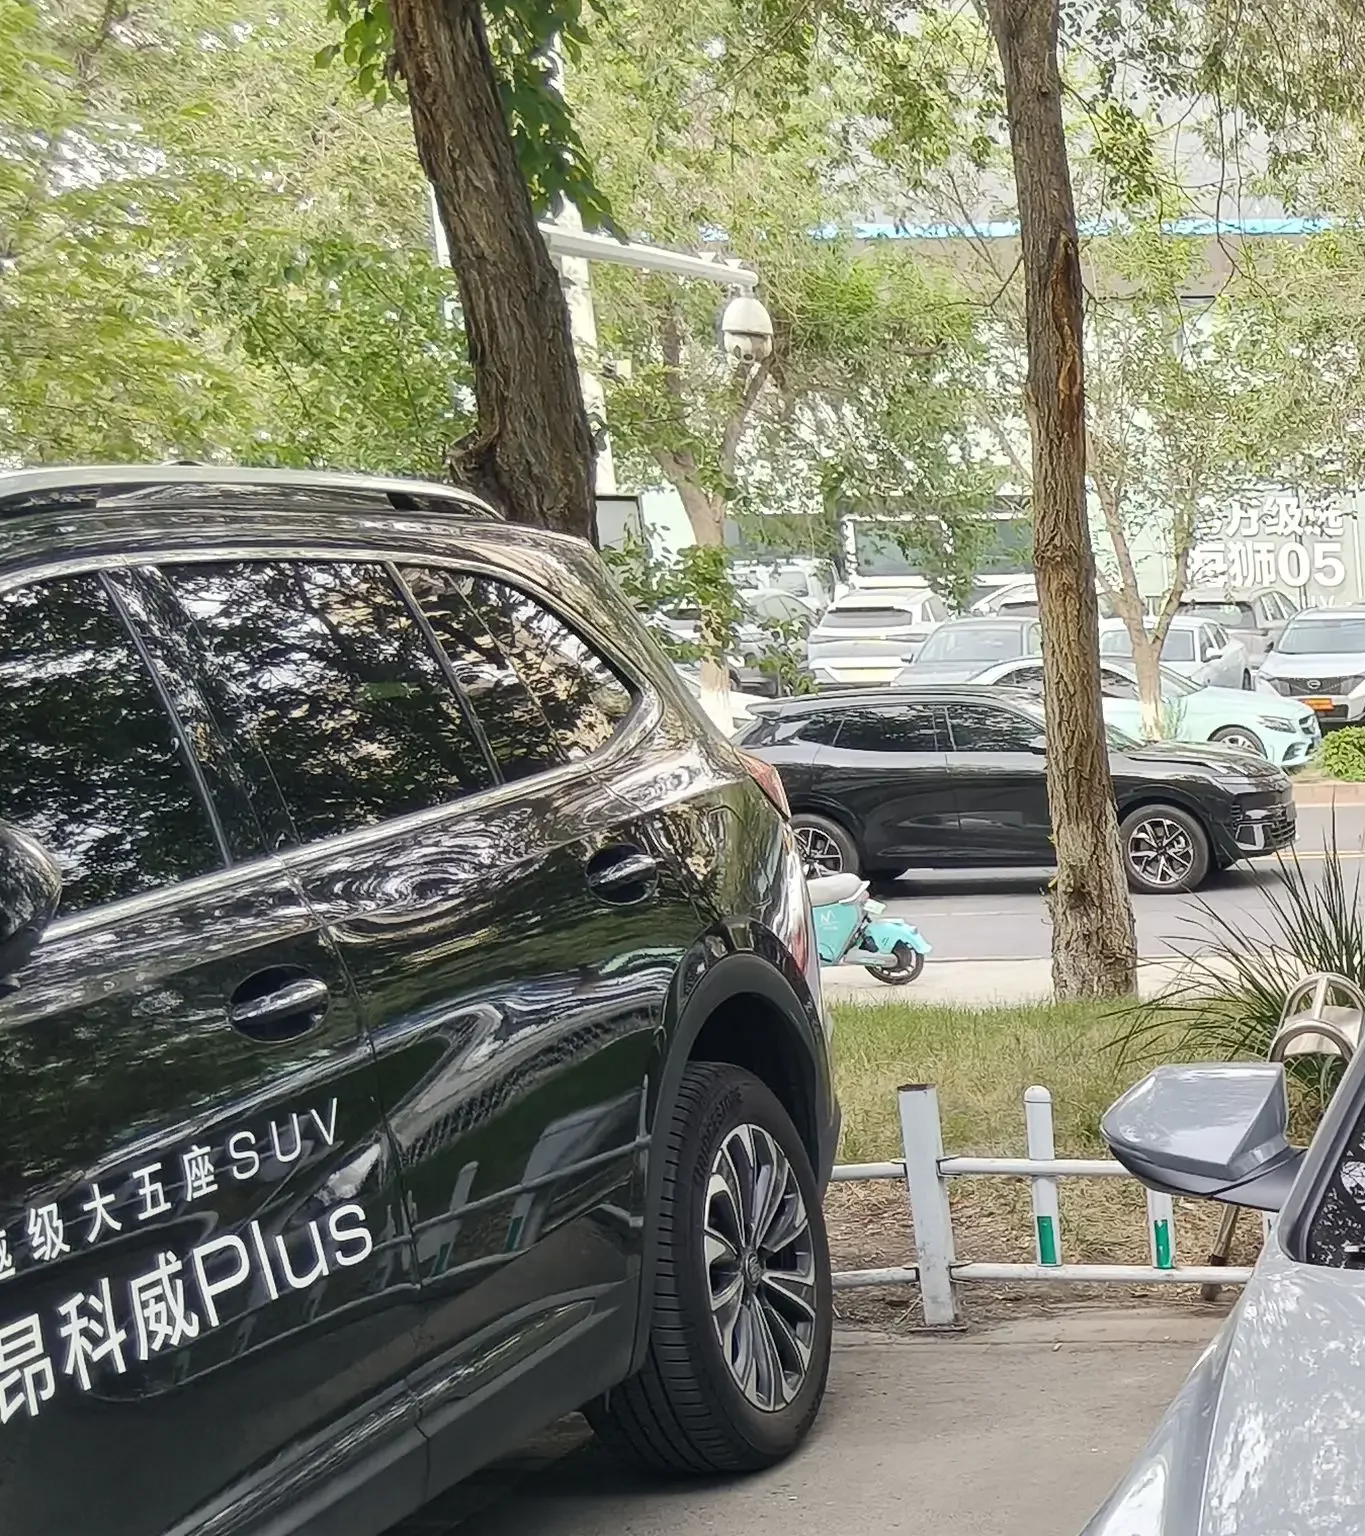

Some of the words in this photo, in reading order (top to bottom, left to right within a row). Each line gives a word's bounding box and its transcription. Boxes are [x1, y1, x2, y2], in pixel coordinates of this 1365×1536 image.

[1188, 541, 1346, 588] 海狮05
[0, 1203, 374, 1424] 昂科威Plus
